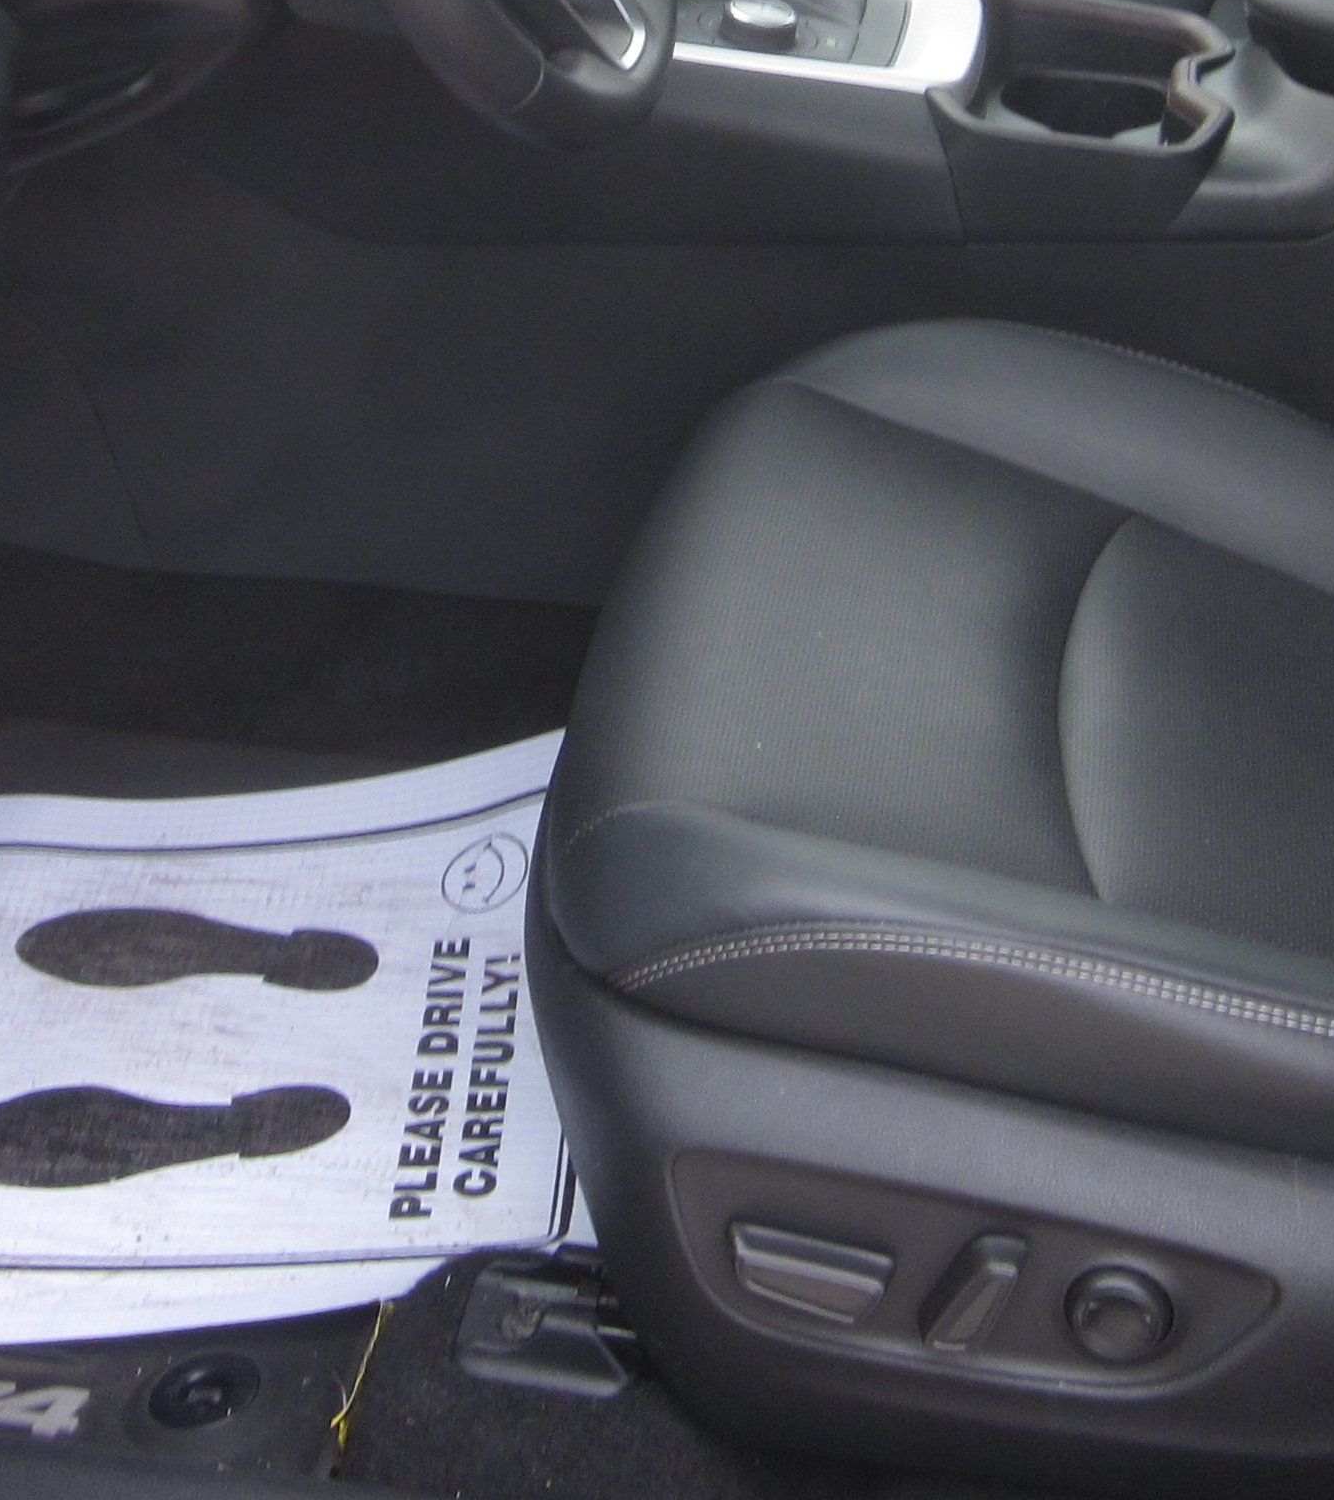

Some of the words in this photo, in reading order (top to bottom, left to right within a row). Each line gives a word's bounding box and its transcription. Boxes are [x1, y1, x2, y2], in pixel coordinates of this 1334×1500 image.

[417, 937, 471, 1057] DRIVE
[388, 1068, 454, 1221] PLEASE
[452, 952, 520, 1198] CAREFULLY!
